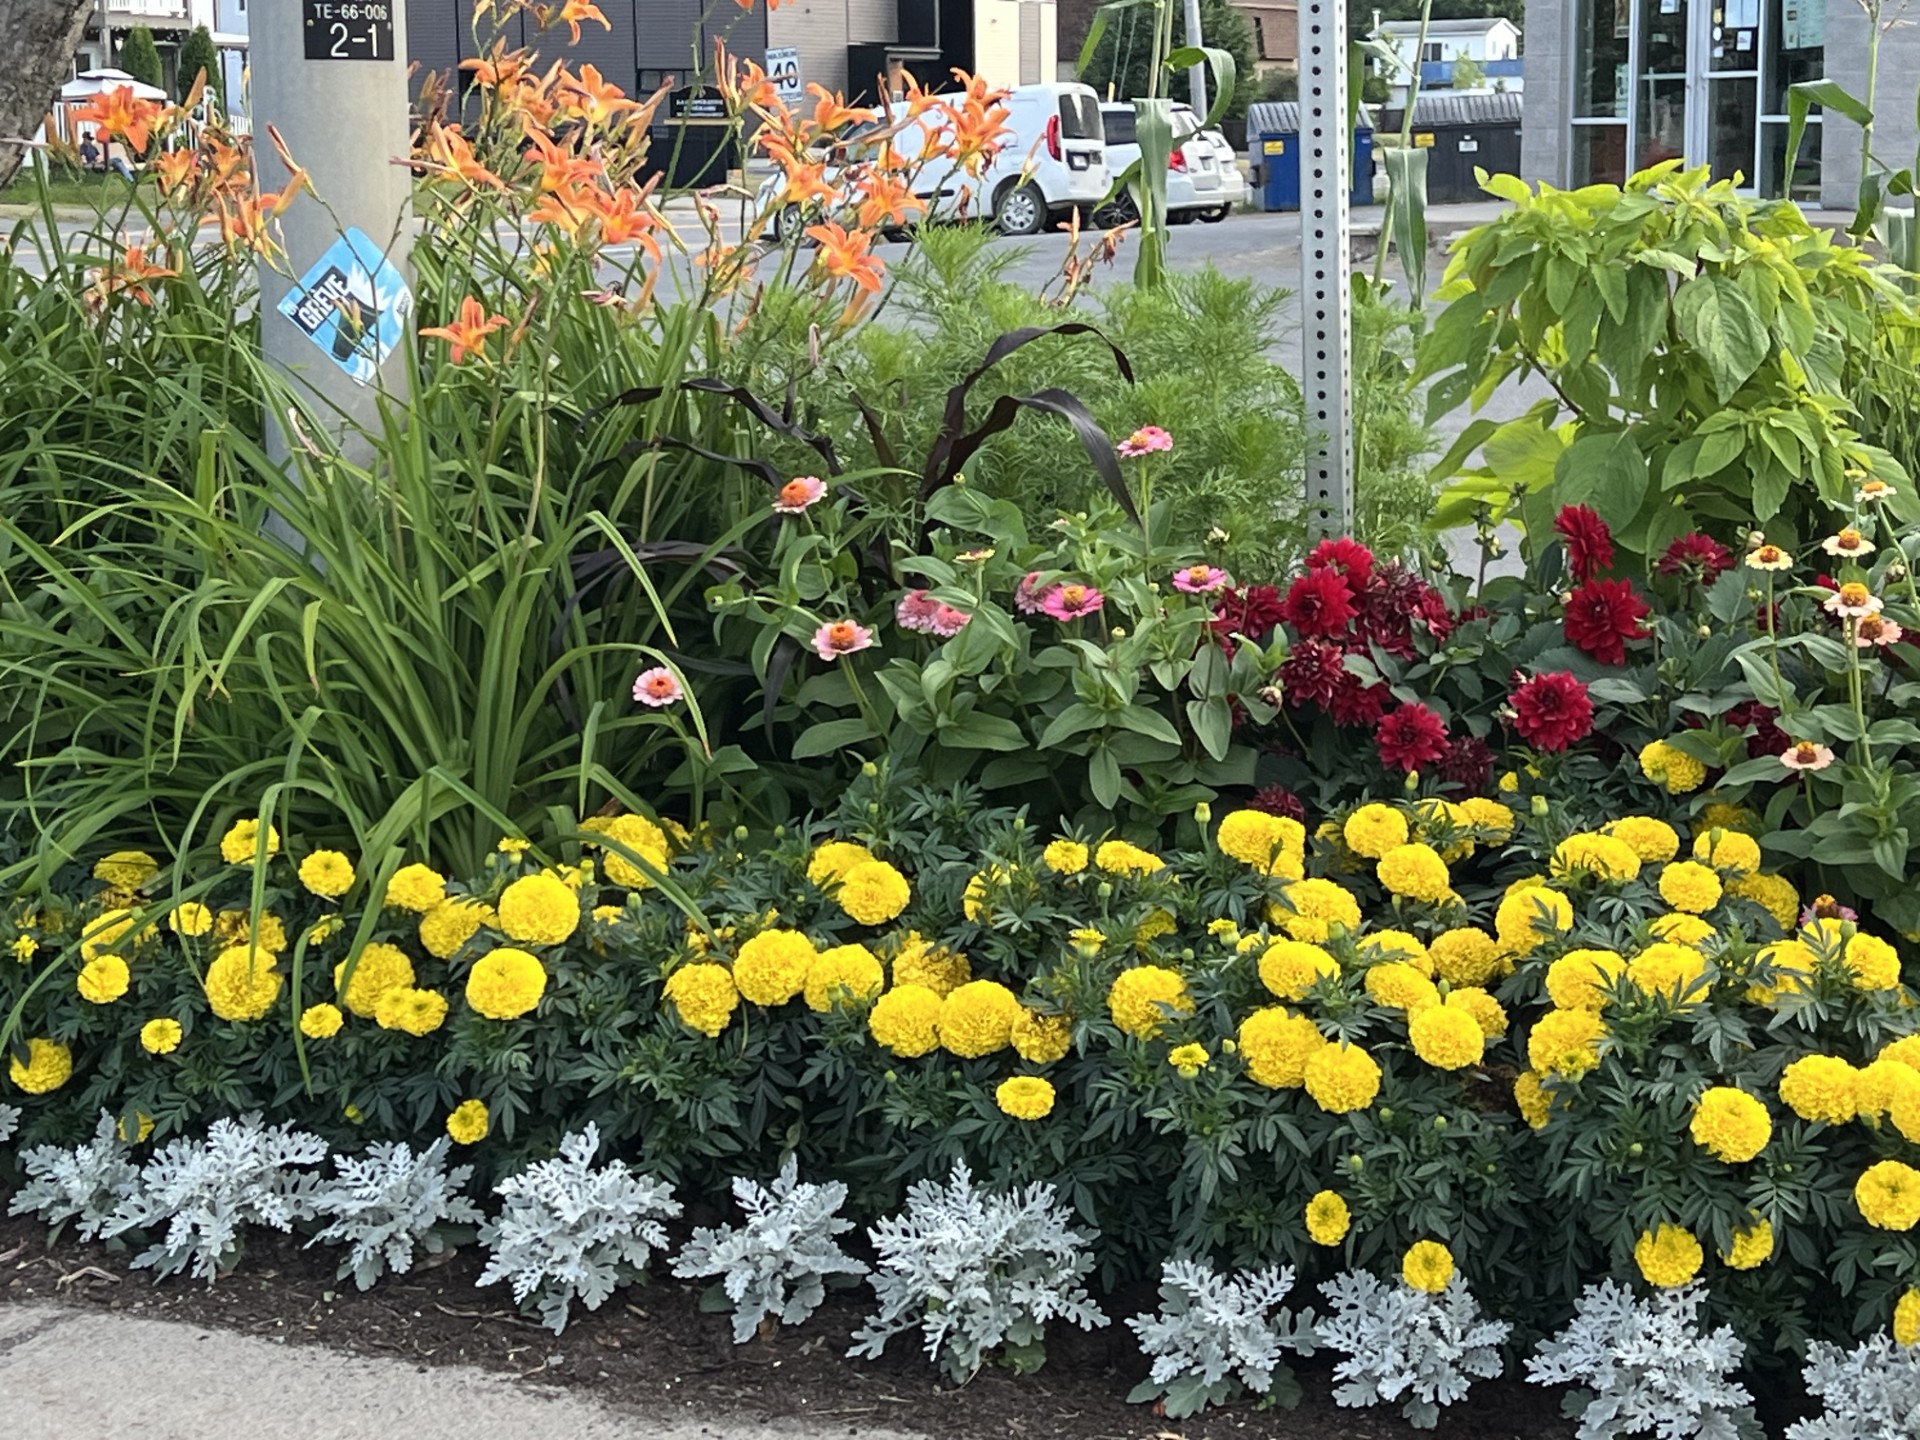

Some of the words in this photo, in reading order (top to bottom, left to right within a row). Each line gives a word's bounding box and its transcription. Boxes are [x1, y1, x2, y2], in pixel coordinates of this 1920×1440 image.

[313, 3, 388, 20] TE-66-006
[330, 22, 378, 58] 2-1
[298, 273, 346, 330] GRÈVE
